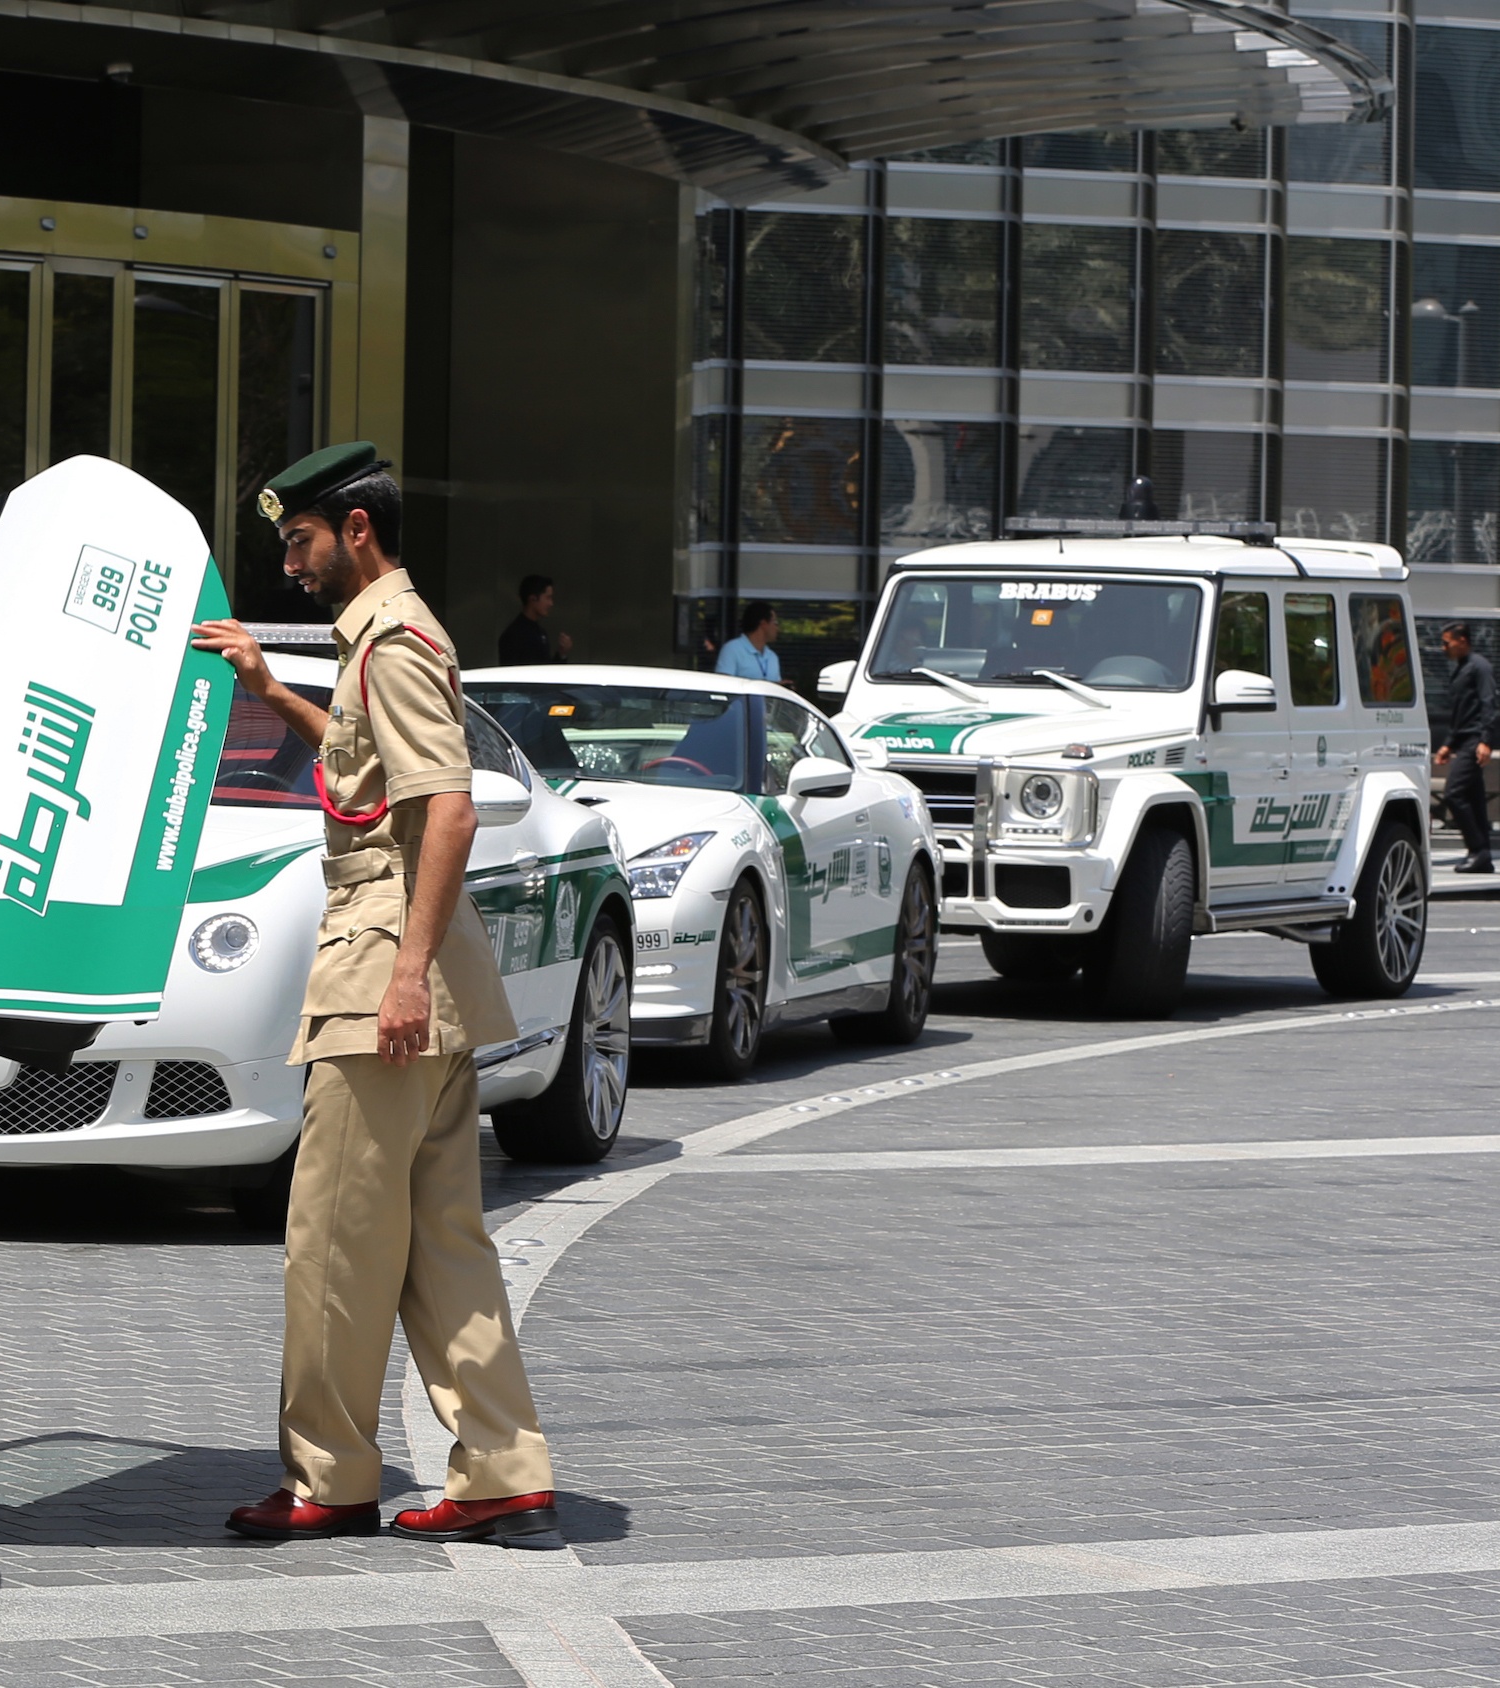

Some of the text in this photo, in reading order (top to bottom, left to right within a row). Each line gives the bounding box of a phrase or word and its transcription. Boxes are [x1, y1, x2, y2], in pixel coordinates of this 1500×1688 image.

[92, 565, 124, 612] 999
[999, 583, 1097, 601] BRABUS
[125, 559, 172, 651] POLICE
[1127, 750, 1156, 768] POLICE
[156, 678, 211, 871] www.dubaipolice.gov.ae
[1249, 794, 1331, 841] الشرطة
[731, 829, 752, 849] POLICE
[637, 933, 661, 949] 999
[672, 930, 716, 946] الشرطة
